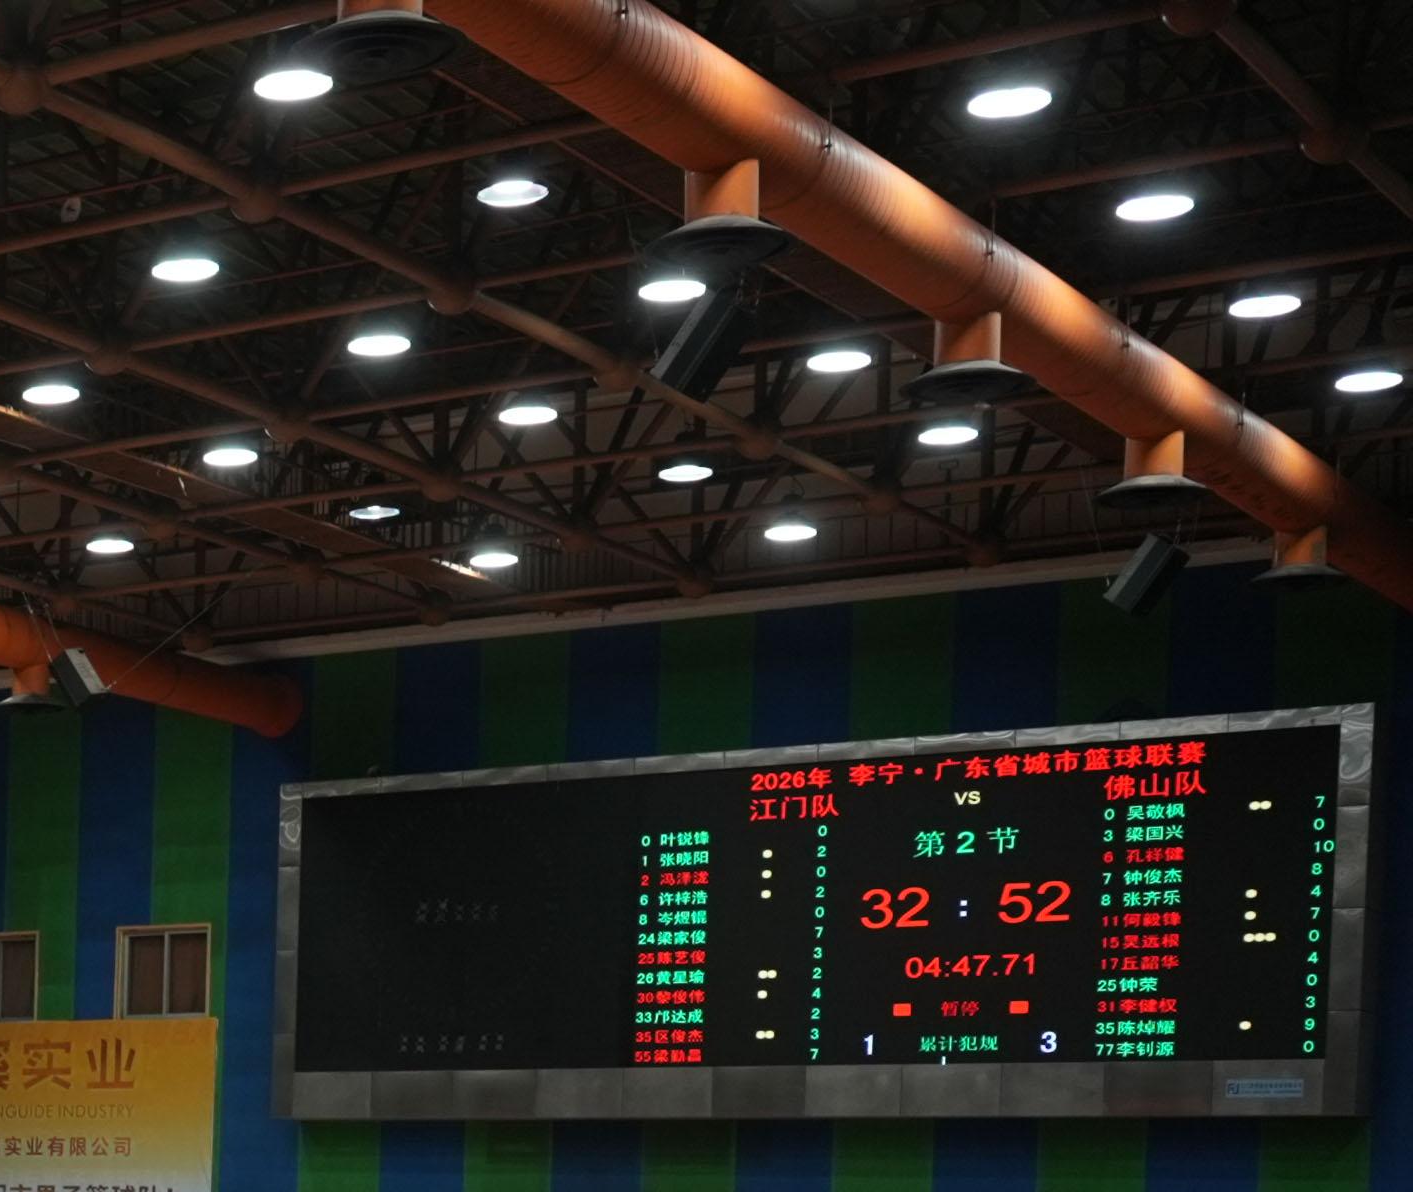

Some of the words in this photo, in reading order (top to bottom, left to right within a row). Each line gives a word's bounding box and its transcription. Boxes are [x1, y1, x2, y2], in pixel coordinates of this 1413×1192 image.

[750, 768, 832, 791] 2026年
[849, 742, 1207, 786] 李宁·广东省城市篮球联赛
[750, 794, 839, 821] 江门队
[954, 791, 981, 805] VS
[1104, 770, 1207, 800] 佛山队
[1104, 808, 1115, 820] 0
[1127, 803, 1185, 820] 吴敬枫
[1315, 796, 1325, 808] 7
[641, 835, 651, 847] 0
[660, 831, 709, 847] 叶锐锋
[818, 825, 827, 837] 0
[1103, 830, 1113, 842] 3
[1125, 825, 1184, 842] 梁国兴
[1313, 818, 1325, 830] 0
[914, 830, 945, 858] 第
[956, 832, 975, 854] 2
[989, 826, 1018, 854] 节
[1103, 851, 1113, 863] 6
[1315, 840, 1335, 852] 10
[643, 856, 647, 866] 1
[660, 851, 709, 867] 张晓阳
[817, 845, 826, 857] 2
[641, 875, 649, 886] 2
[816, 866, 826, 878] 0
[1103, 873, 1112, 884] 7
[1123, 868, 1182, 885] 钟俊杰
[1311, 863, 1322, 875] 8
[640, 894, 648, 906] 6
[658, 890, 708, 906] 许梓浩
[815, 886, 825, 898] 2
[860, 887, 929, 929] 32
[998, 880, 1070, 924] 52
[1101, 894, 1111, 906] 8
[1123, 890, 1180, 907] 张齐乐
[1311, 885, 1321, 897] 4
[639, 914, 648, 925] 8
[815, 906, 825, 918] 0
[1103, 916, 1119, 927] 11
[1311, 907, 1320, 919] 7
[638, 933, 655, 945] 24
[657, 930, 706, 945] 梁家俊
[815, 926, 823, 938] 7
[1103, 937, 1120, 949] 15
[1308, 929, 1320, 942] 0
[638, 953, 655, 964] 25
[813, 947, 822, 959] 3
[1101, 958, 1119, 970] 17
[1307, 952, 1318, 963] 4
[637, 972, 654, 984] 26
[656, 969, 705, 985] 黄星瑜
[812, 967, 822, 979] 2
[905, 953, 1036, 979] 04:47.71
[1097, 979, 1117, 992] 25
[1119, 977, 1158, 992] 钟荣
[1306, 974, 1317, 986] 0
[637, 992, 654, 1004] 30
[812, 987, 821, 999] 4
[1098, 1001, 1115, 1012] 31
[1305, 996, 1315, 1008] 3
[635, 1012, 652, 1023] 33
[811, 1008, 820, 1019] 2
[636, 1031, 652, 1043] 35
[810, 1028, 819, 1040] 3
[1095, 1022, 1115, 1035] 35
[1305, 1018, 1315, 1030] 9
[863, 1034, 874, 1055] 1
[919, 1035, 998, 1052] 累计犯规
[1040, 1032, 1057, 1053] 3
[1096, 1044, 1114, 1055] 77
[1303, 1040, 1314, 1052] 0
[635, 1051, 651, 1062] 55
[810, 1048, 819, 1059] 7
[58, 1104, 133, 1118] INDUSTRY
